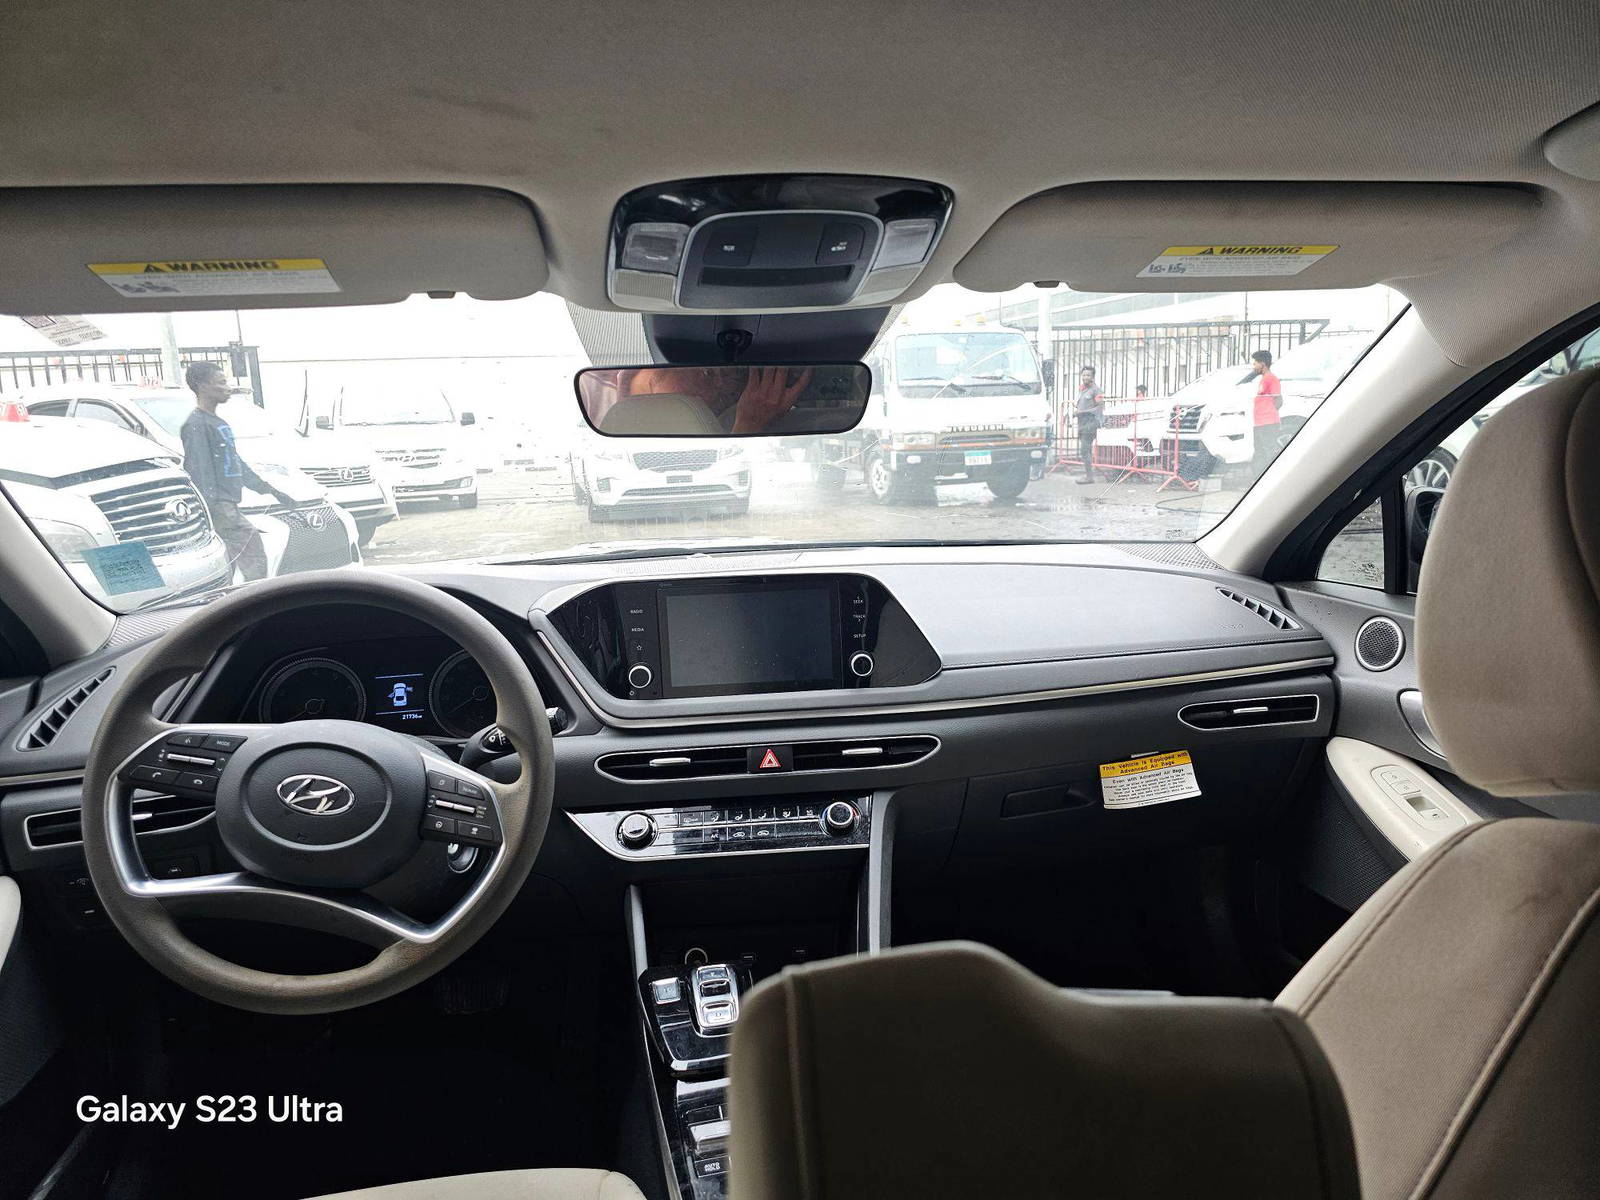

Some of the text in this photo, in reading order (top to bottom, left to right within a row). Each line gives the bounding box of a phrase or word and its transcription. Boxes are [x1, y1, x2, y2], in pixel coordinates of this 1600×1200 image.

[1219, 246, 1303, 255] WARNING
[166, 260, 280, 272] WARNING
[1120, 761, 1139, 769] Vehicle
[1150, 754, 1175, 764] Equipped
[1120, 765, 1148, 774] Advanced
